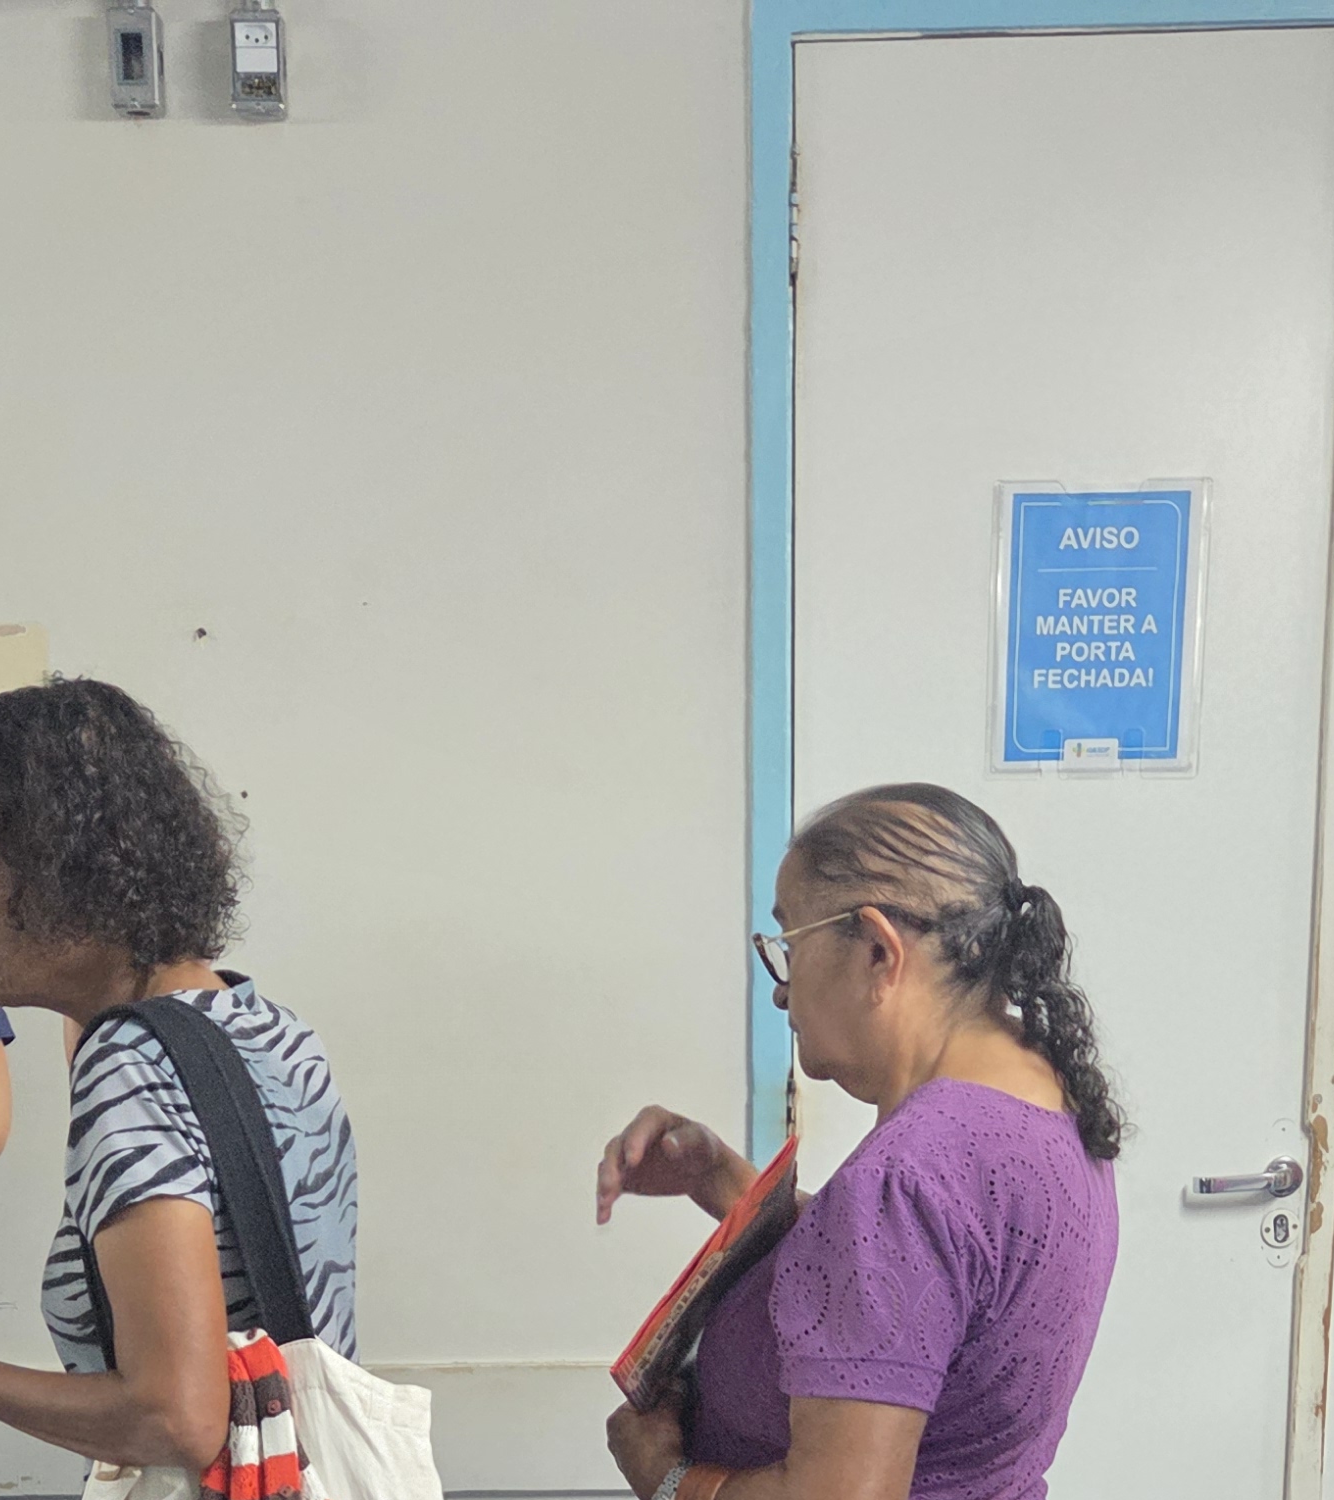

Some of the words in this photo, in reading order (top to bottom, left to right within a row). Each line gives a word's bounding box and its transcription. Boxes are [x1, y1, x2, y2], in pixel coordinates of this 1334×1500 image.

[1058, 526, 1141, 551] AVISO
[1058, 587, 1137, 609] FAVOR
[1036, 614, 1135, 636] MANTER
[1140, 614, 1158, 634] A
[1056, 641, 1135, 662] PORTA
[1033, 667, 1154, 689] FECHADA!
